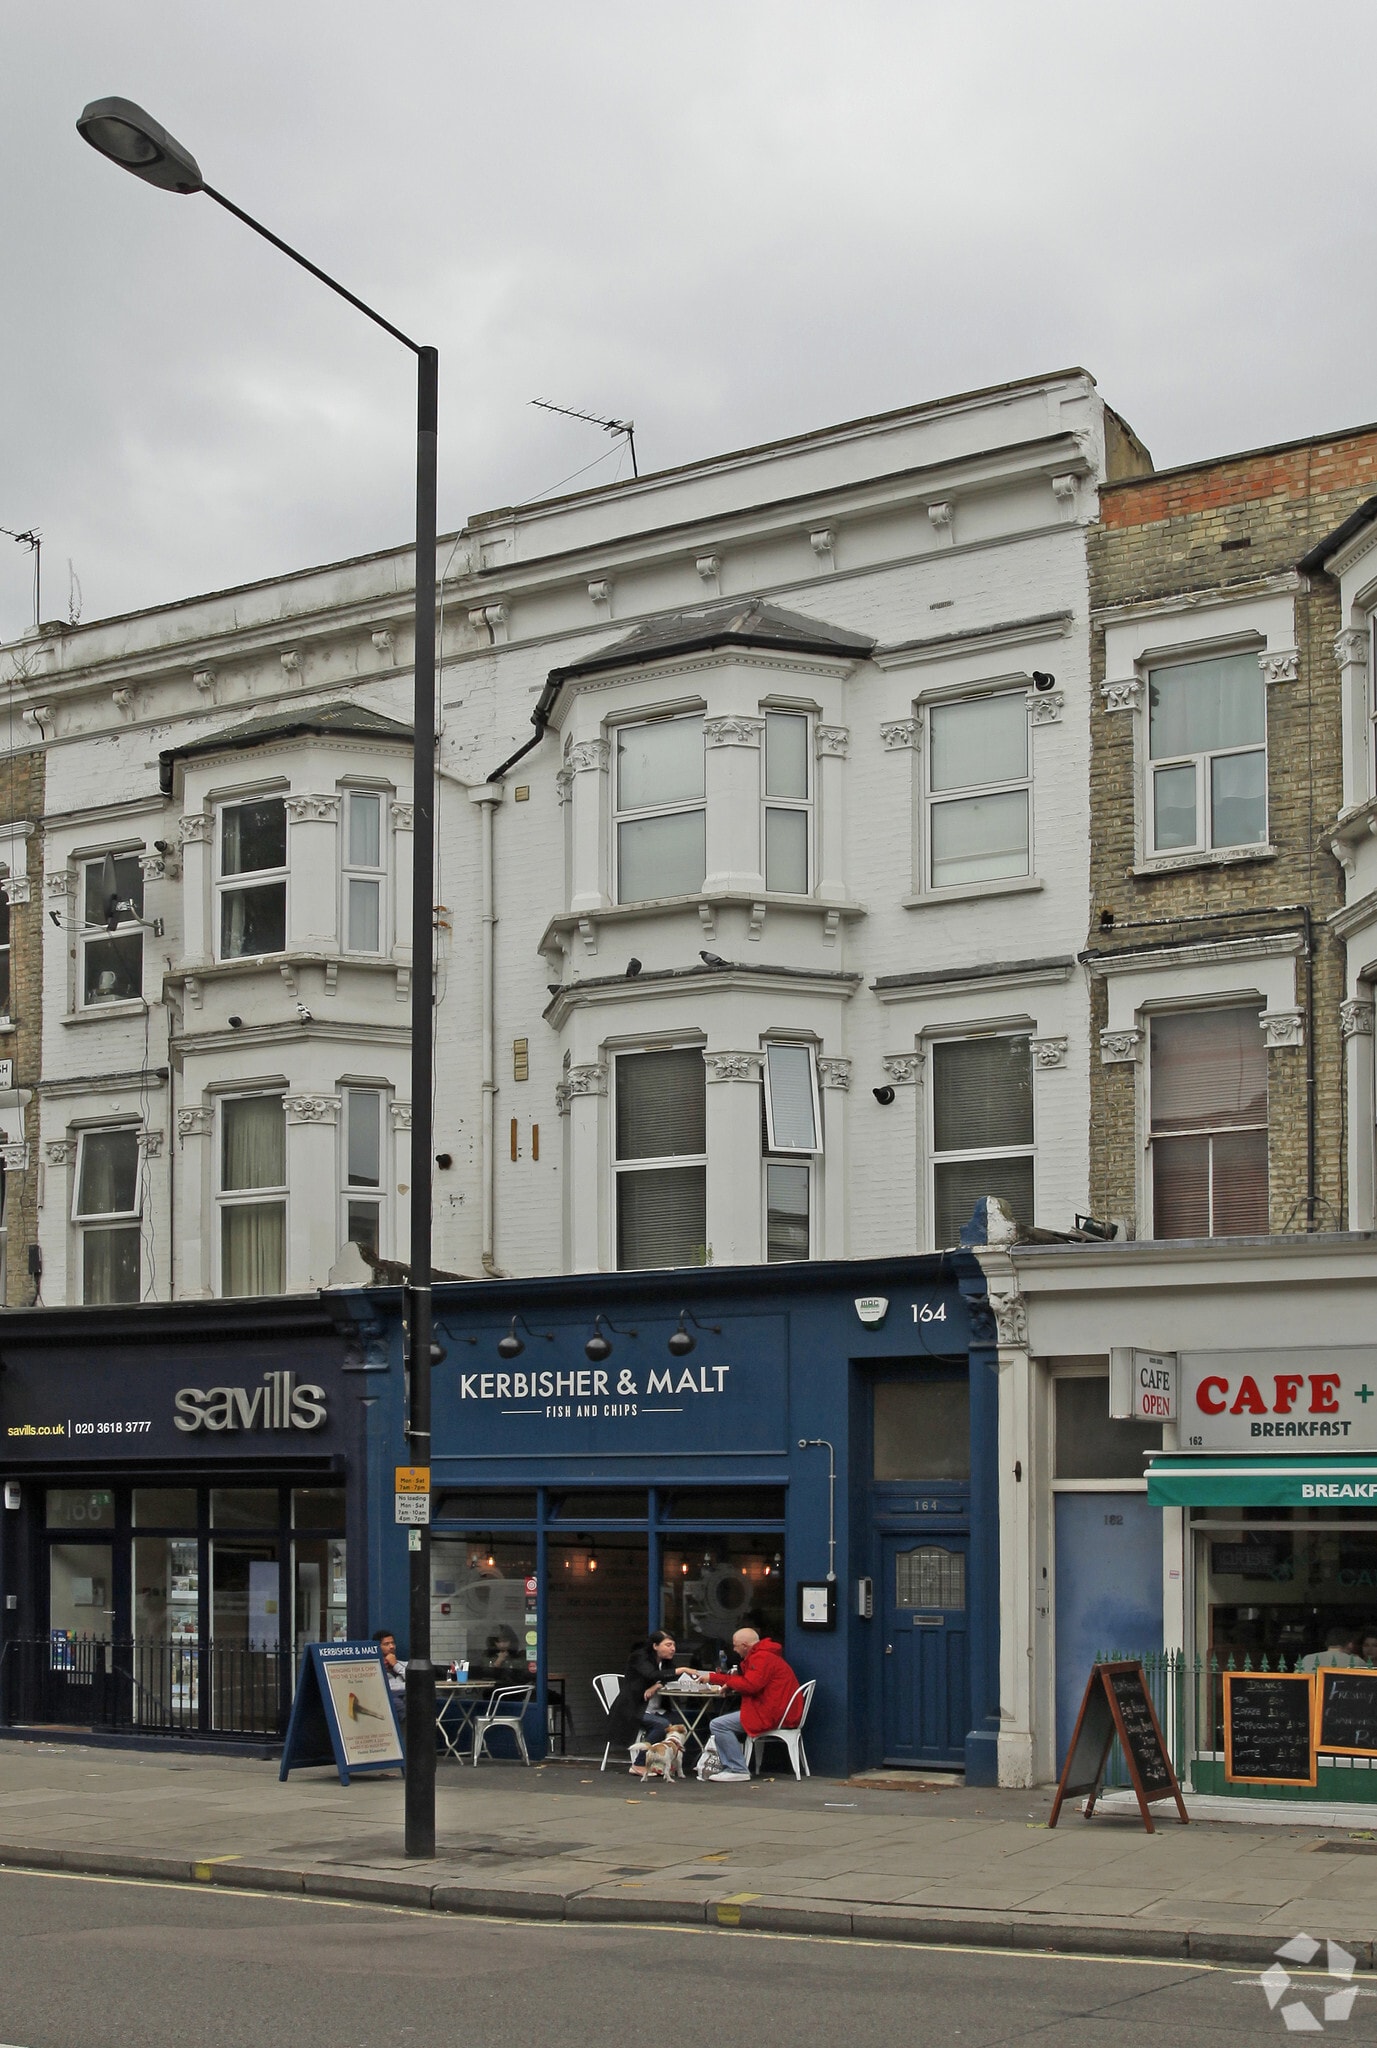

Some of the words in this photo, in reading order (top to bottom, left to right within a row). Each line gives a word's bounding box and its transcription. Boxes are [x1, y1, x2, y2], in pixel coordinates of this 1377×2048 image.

[910, 1302, 947, 1323] 164
[460, 1369, 610, 1399] KERBISHER
[616, 1368, 639, 1395] &
[646, 1365, 730, 1394] MALT
[1140, 1367, 1170, 1392] CAFE
[173, 1370, 328, 1431] savills
[1195, 1373, 1341, 1415] CAFE
[546, 1405, 571, 1418] FISH
[576, 1404, 598, 1417] AND
[603, 1403, 638, 1416] CHIPS
[1142, 1394, 1170, 1416] OPEN
[7, 1424, 65, 1437] savills.co.uk
[75, 1422, 94, 1434] 020
[97, 1421, 122, 1433] 3618
[125, 1420, 152, 1433] 3777
[1250, 1421, 1352, 1437] BREAKFAST
[1189, 1436, 1203, 1446] 162
[915, 1501, 938, 1511] 164
[319, 1647, 354, 1656] KERBISHER
[354, 1647, 360, 1655] &
[361, 1645, 378, 1655] MALT
[1246, 1680, 1283, 1690] DRINKS
[1235, 1734, 1249, 1742] HOT
[1234, 1749, 1261, 1758] LATTE
